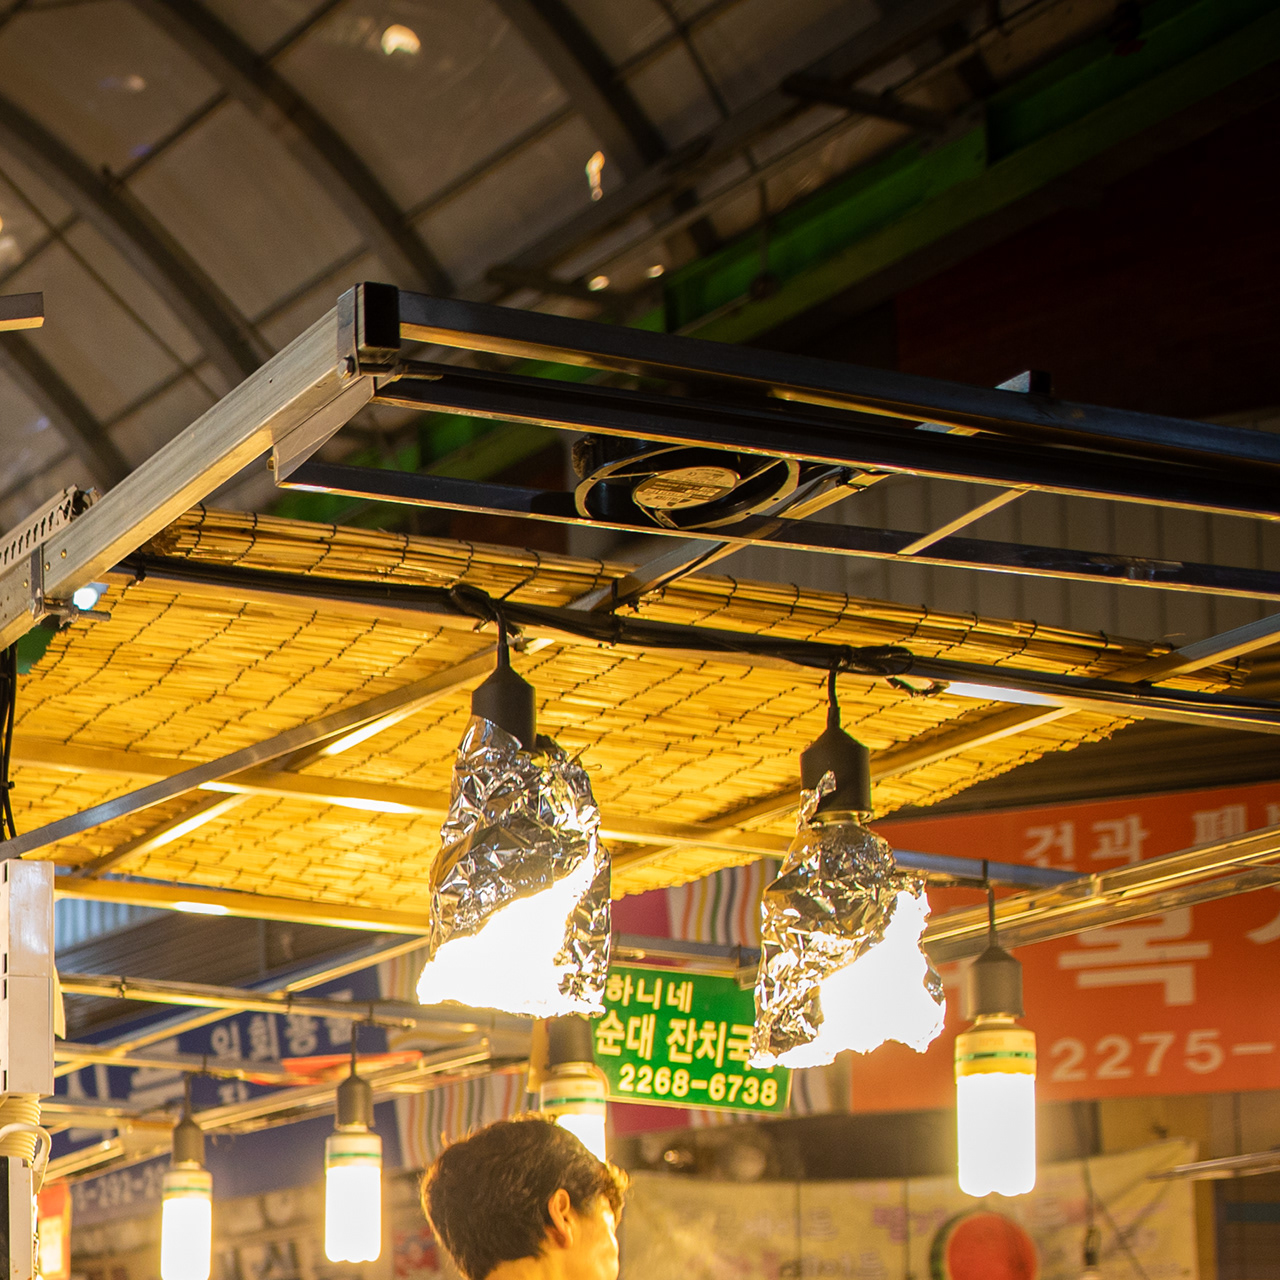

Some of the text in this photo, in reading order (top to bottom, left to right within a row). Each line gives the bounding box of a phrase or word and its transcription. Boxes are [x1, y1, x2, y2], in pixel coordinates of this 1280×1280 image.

[606, 974, 693, 1013] 하니네
[595, 1009, 774, 1072] 순대 잔치국
[618, 1063, 778, 1106] 2268-6738
